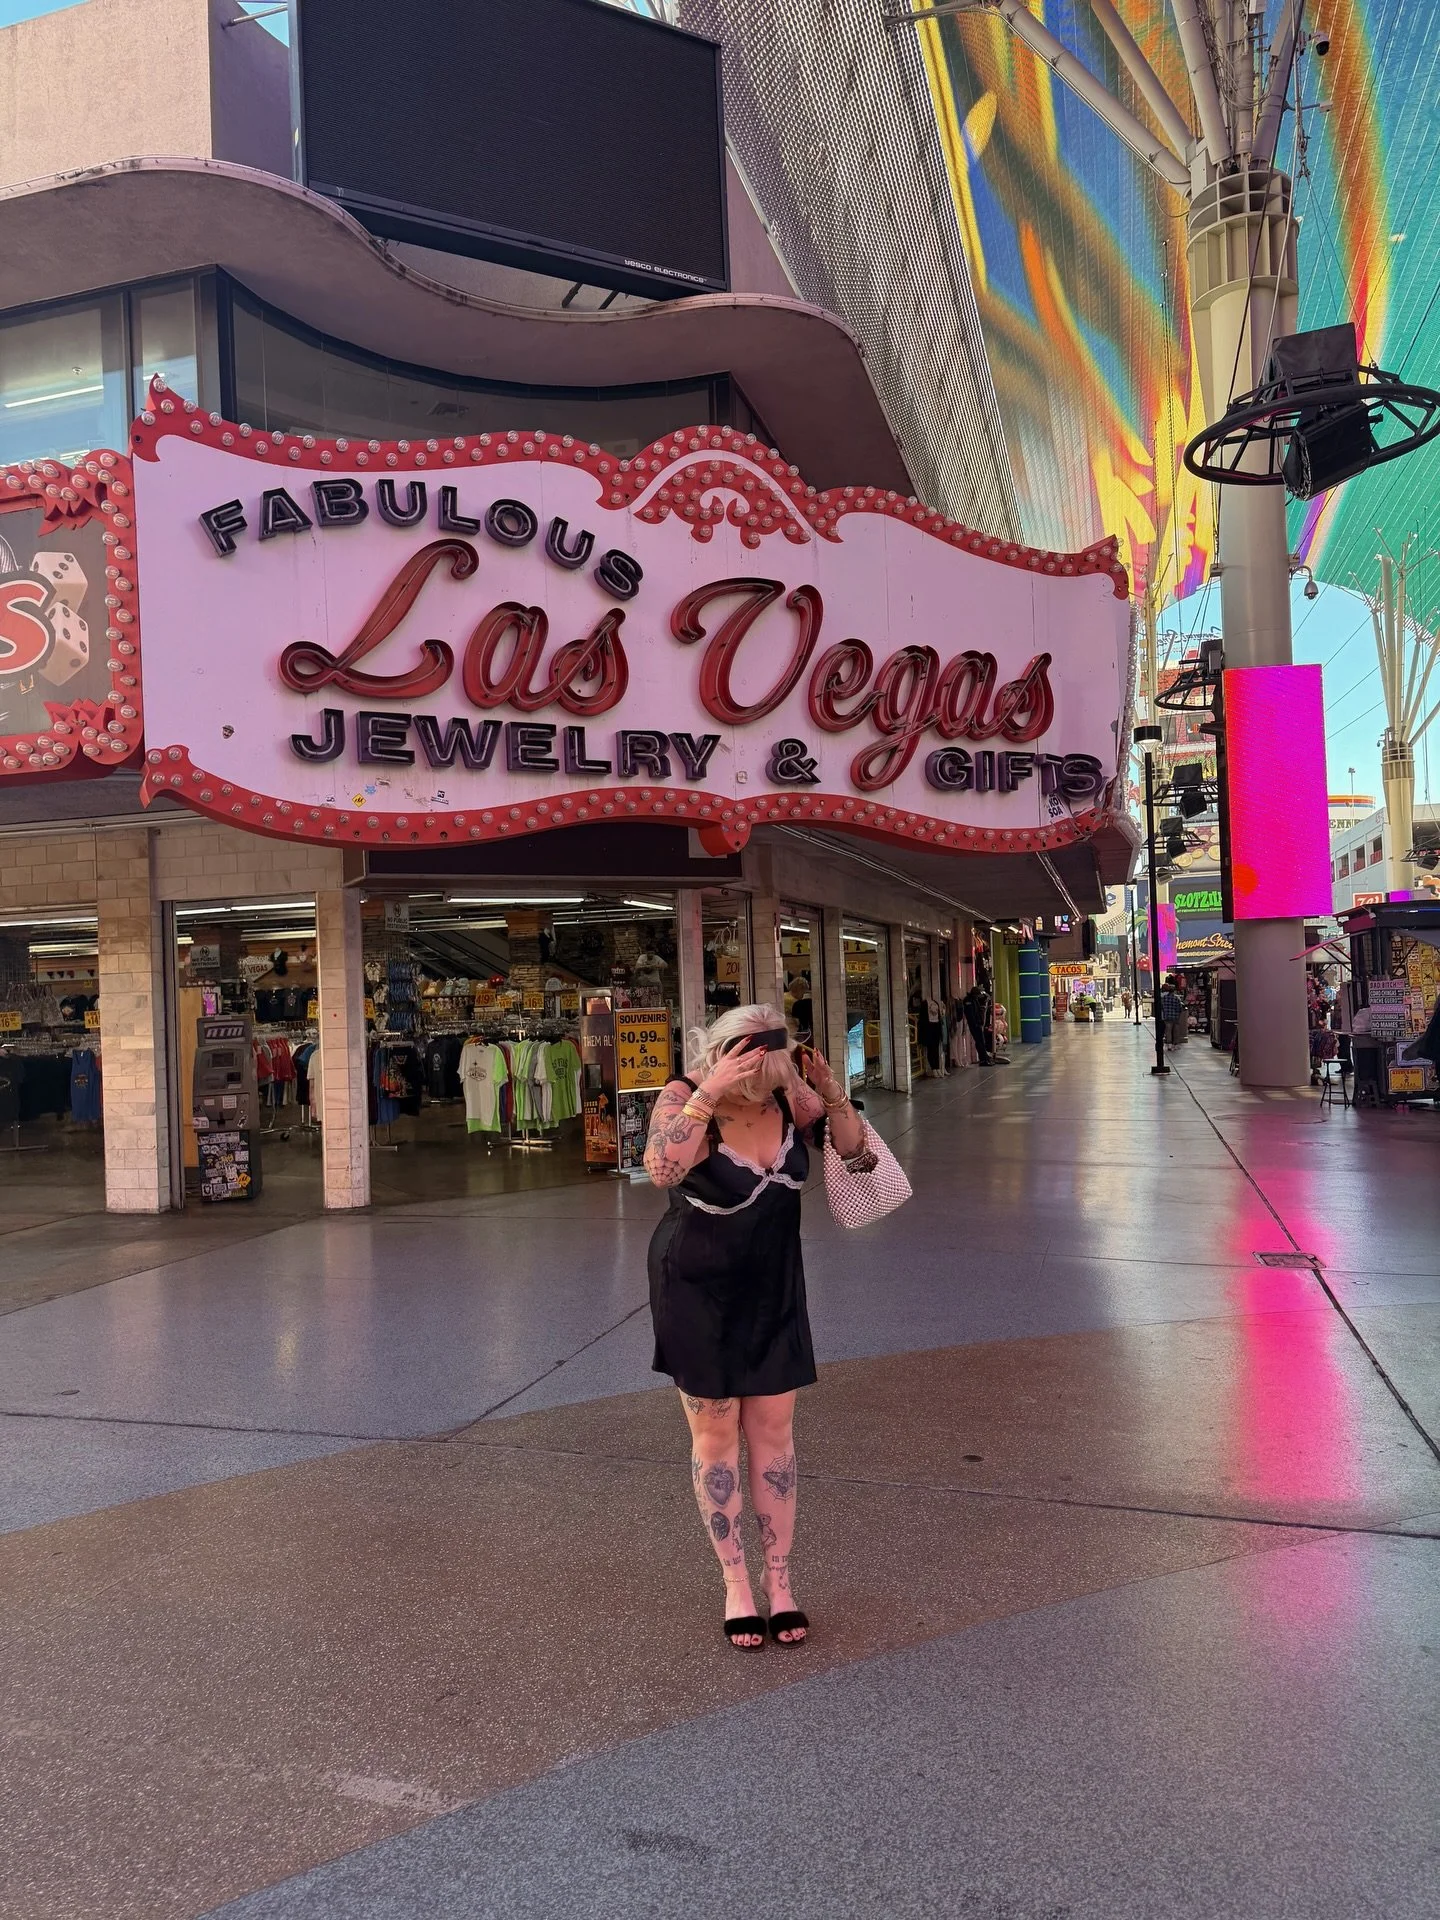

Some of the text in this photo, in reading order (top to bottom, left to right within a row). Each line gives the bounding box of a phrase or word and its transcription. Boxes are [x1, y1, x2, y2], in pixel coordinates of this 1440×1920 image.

[199, 478, 643, 600] FABULOUS
[278, 538, 1055, 791] Las Vegas
[289, 709, 1105, 797] JEWELRY & GIFTS
[1056, 966, 1082, 974] TACOS
[620, 1013, 667, 1024] SOUVENIRS
[639, 1044, 648, 1054] &
